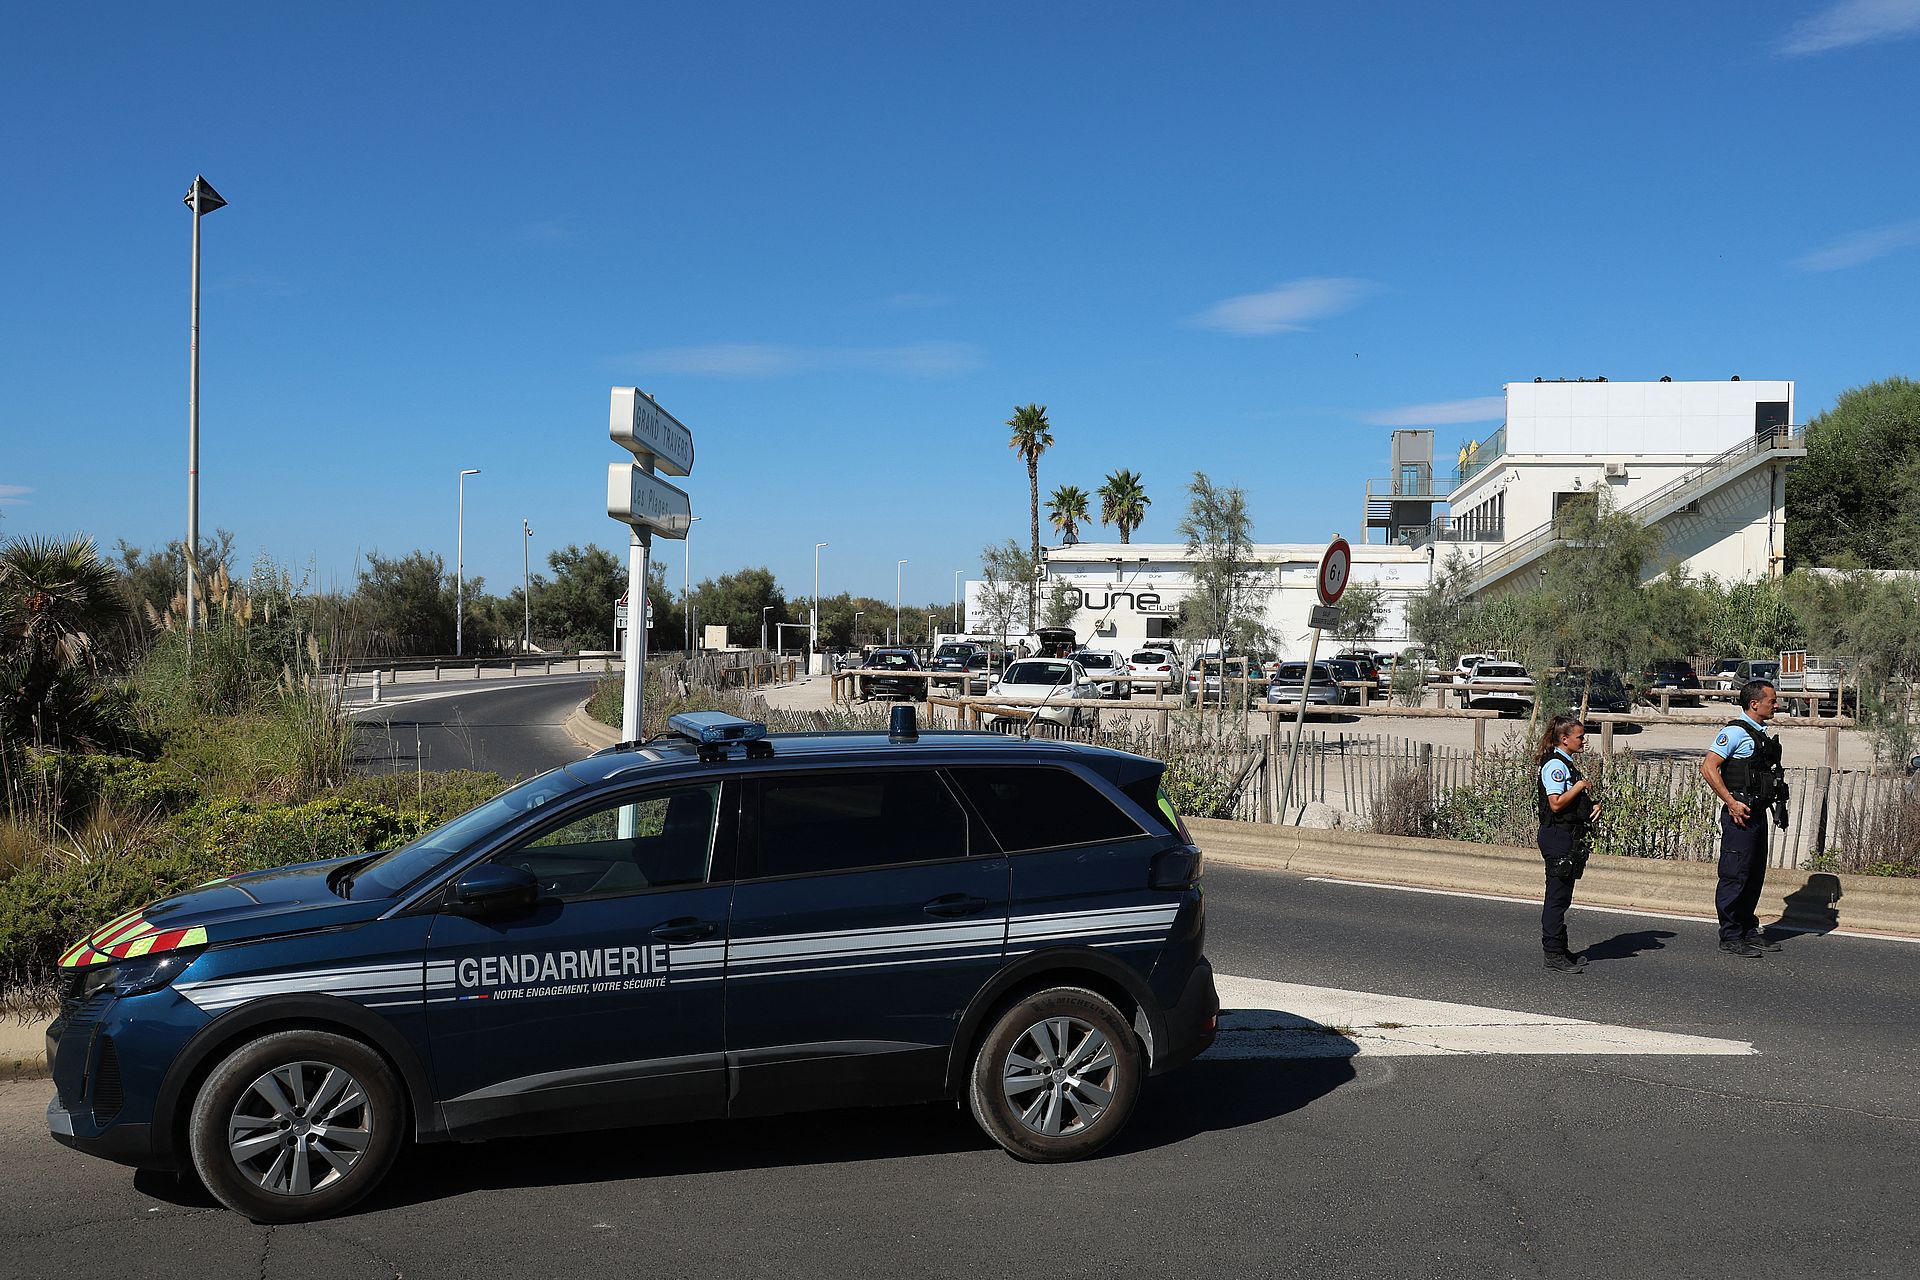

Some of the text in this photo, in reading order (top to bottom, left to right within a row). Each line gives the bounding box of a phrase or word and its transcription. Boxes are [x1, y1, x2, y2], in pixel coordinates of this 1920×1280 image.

[636, 405, 688, 461] GRAND TRAVERS
[633, 480, 645, 507] Les
[458, 944, 668, 988] GENDARMERIE
[493, 976, 667, 1000] NOTRE ENGAGEMENT, VOTRE SÉCURITÉ
[1056, 997, 1105, 1015] MICHELIN
